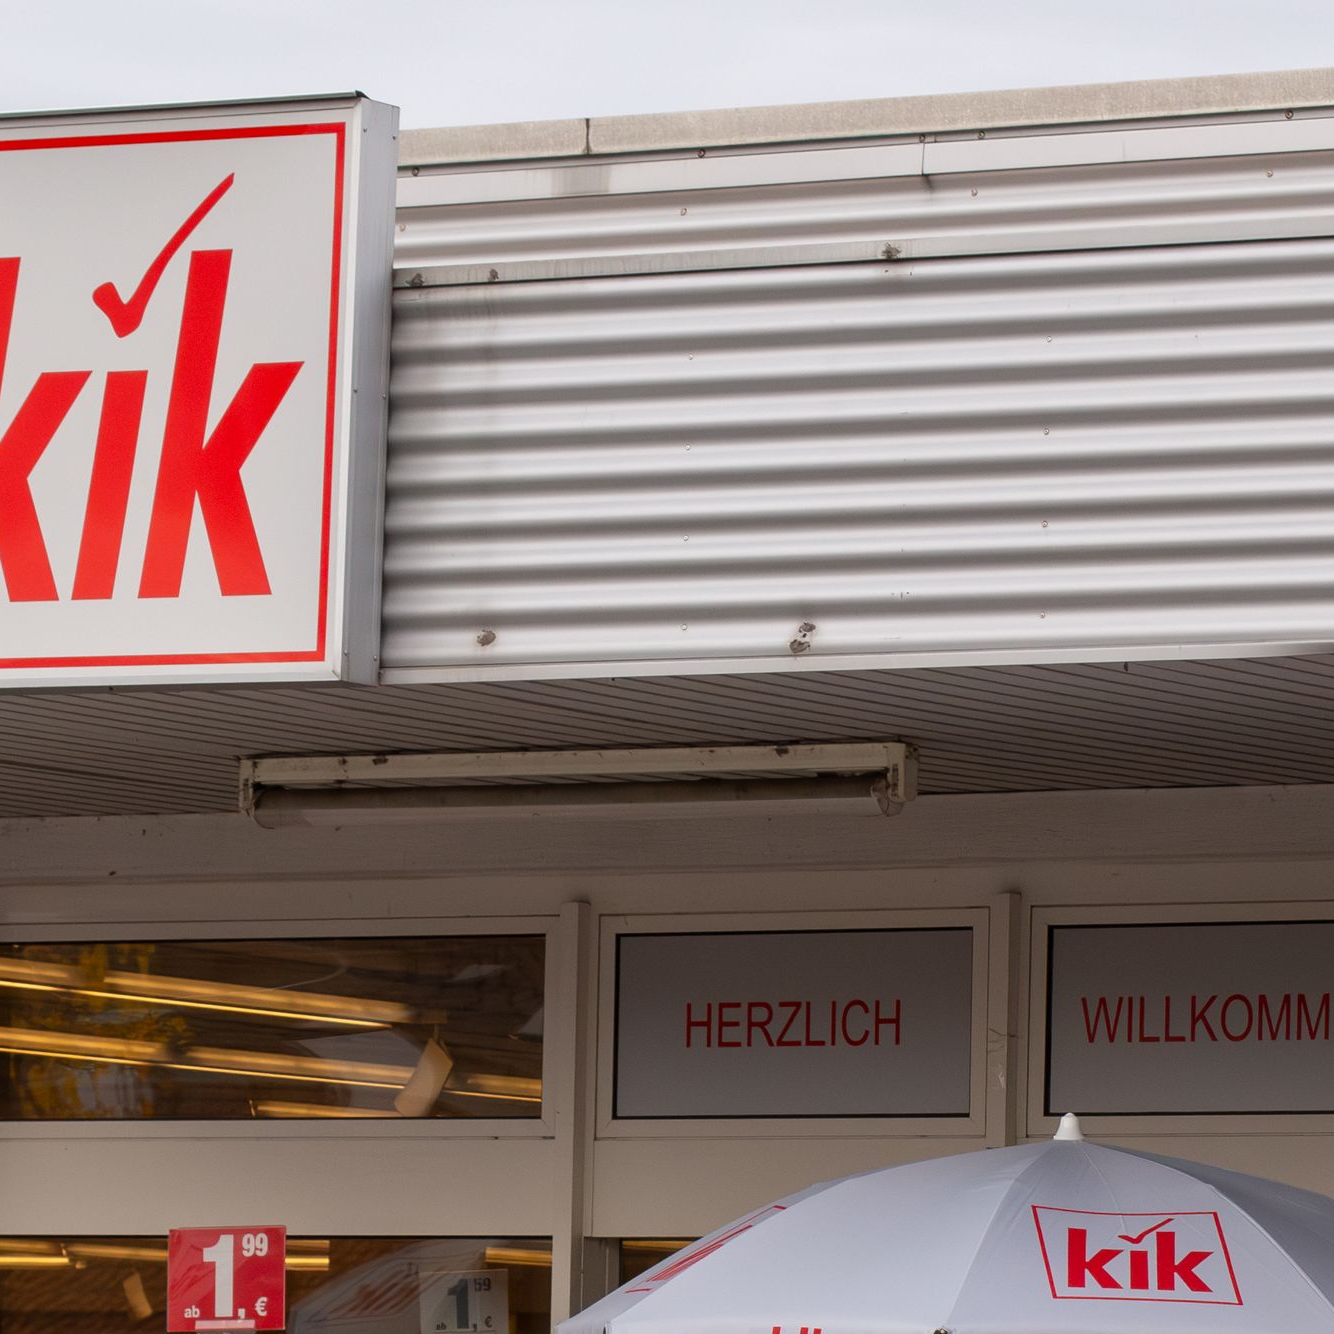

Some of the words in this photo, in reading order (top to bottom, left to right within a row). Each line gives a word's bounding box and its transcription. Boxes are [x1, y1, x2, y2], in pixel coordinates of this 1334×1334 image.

[684, 998, 902, 1049] HERZLICH
[1067, 1216, 1215, 1294] kik
[184, 1303, 201, 1319] ab
[253, 1295, 269, 1318] €
